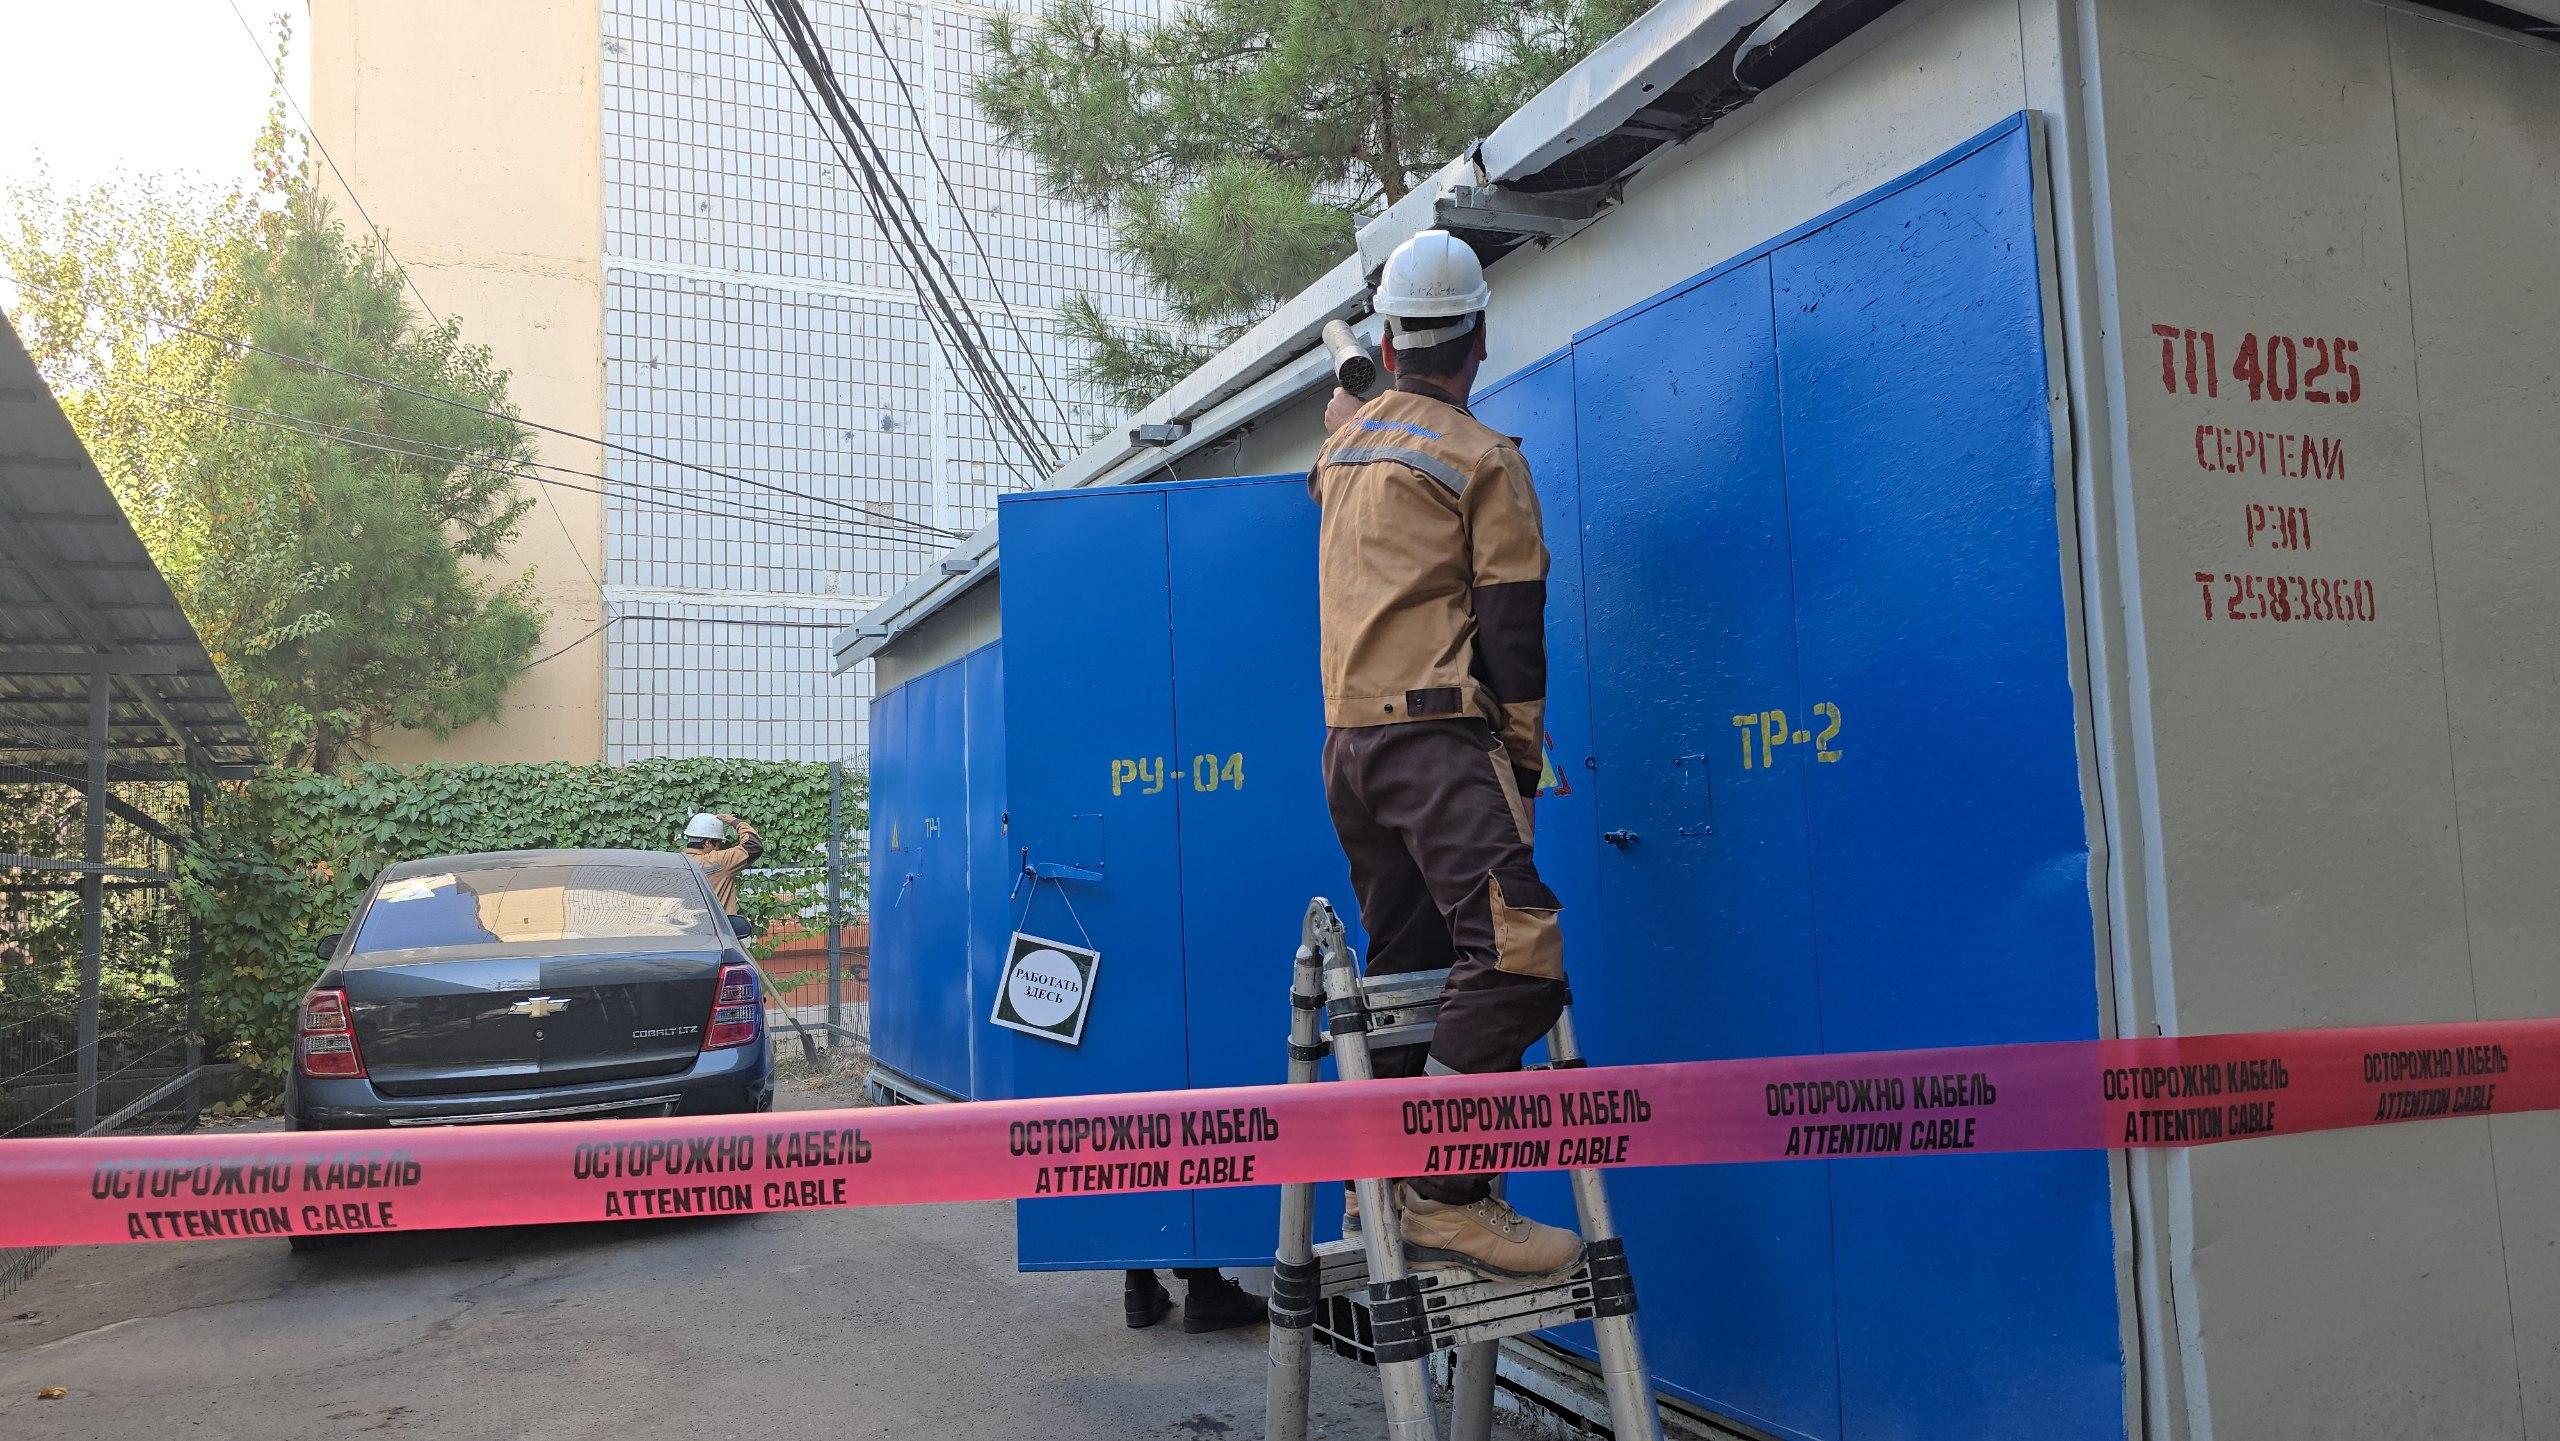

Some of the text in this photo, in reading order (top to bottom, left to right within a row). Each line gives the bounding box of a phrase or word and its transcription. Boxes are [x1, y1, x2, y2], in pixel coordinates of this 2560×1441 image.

[2152, 324, 2361, 403] ТП 4025
[2195, 425, 2346, 481] СЕРГЕЛИ
[1732, 702, 1843, 769] ТР-2
[1112, 752, 1245, 796] РУ-04
[1016, 968, 1079, 993] РАБОТАТЬ
[1024, 985, 1063, 1004] ЗДЕСЬ
[632, 1025, 698, 1038] COBALT LTZ
[2102, 1058, 2289, 1101] ОСТОРОЖНО КАБЕЛЬ
[2363, 1044, 2508, 1084] ОСТОРОЖНО КАБЕЛЬ
[1402, 1089, 1651, 1135] ОСТОРОЖНО КАБЕЛЬ
[1765, 1073, 1997, 1117] ОСТОРОЖНО КАБЕЛЬ
[2374, 1084, 2496, 1121] ATTENTION CABLE
[1009, 1106, 1279, 1157] ОСТОРОЖНО КАБЕЛЬ
[1785, 1118, 1976, 1156] ATTENTION CABLE
[2124, 1101, 2275, 1143] ATTENTION CABLE
[92, 1148, 422, 1200] ОСТОРОЖНО КАБЕЛЬ
[573, 1128, 872, 1179] ОСТОРОЖНО КАБЕЛЬ
[1035, 1155, 1256, 1194] ATTENTION CABLE
[1424, 1135, 1629, 1172] ATTENTION CABLE
[605, 1178, 847, 1217] ATTENTION CABLE
[127, 1201, 398, 1240] ATTENTION CABLE
